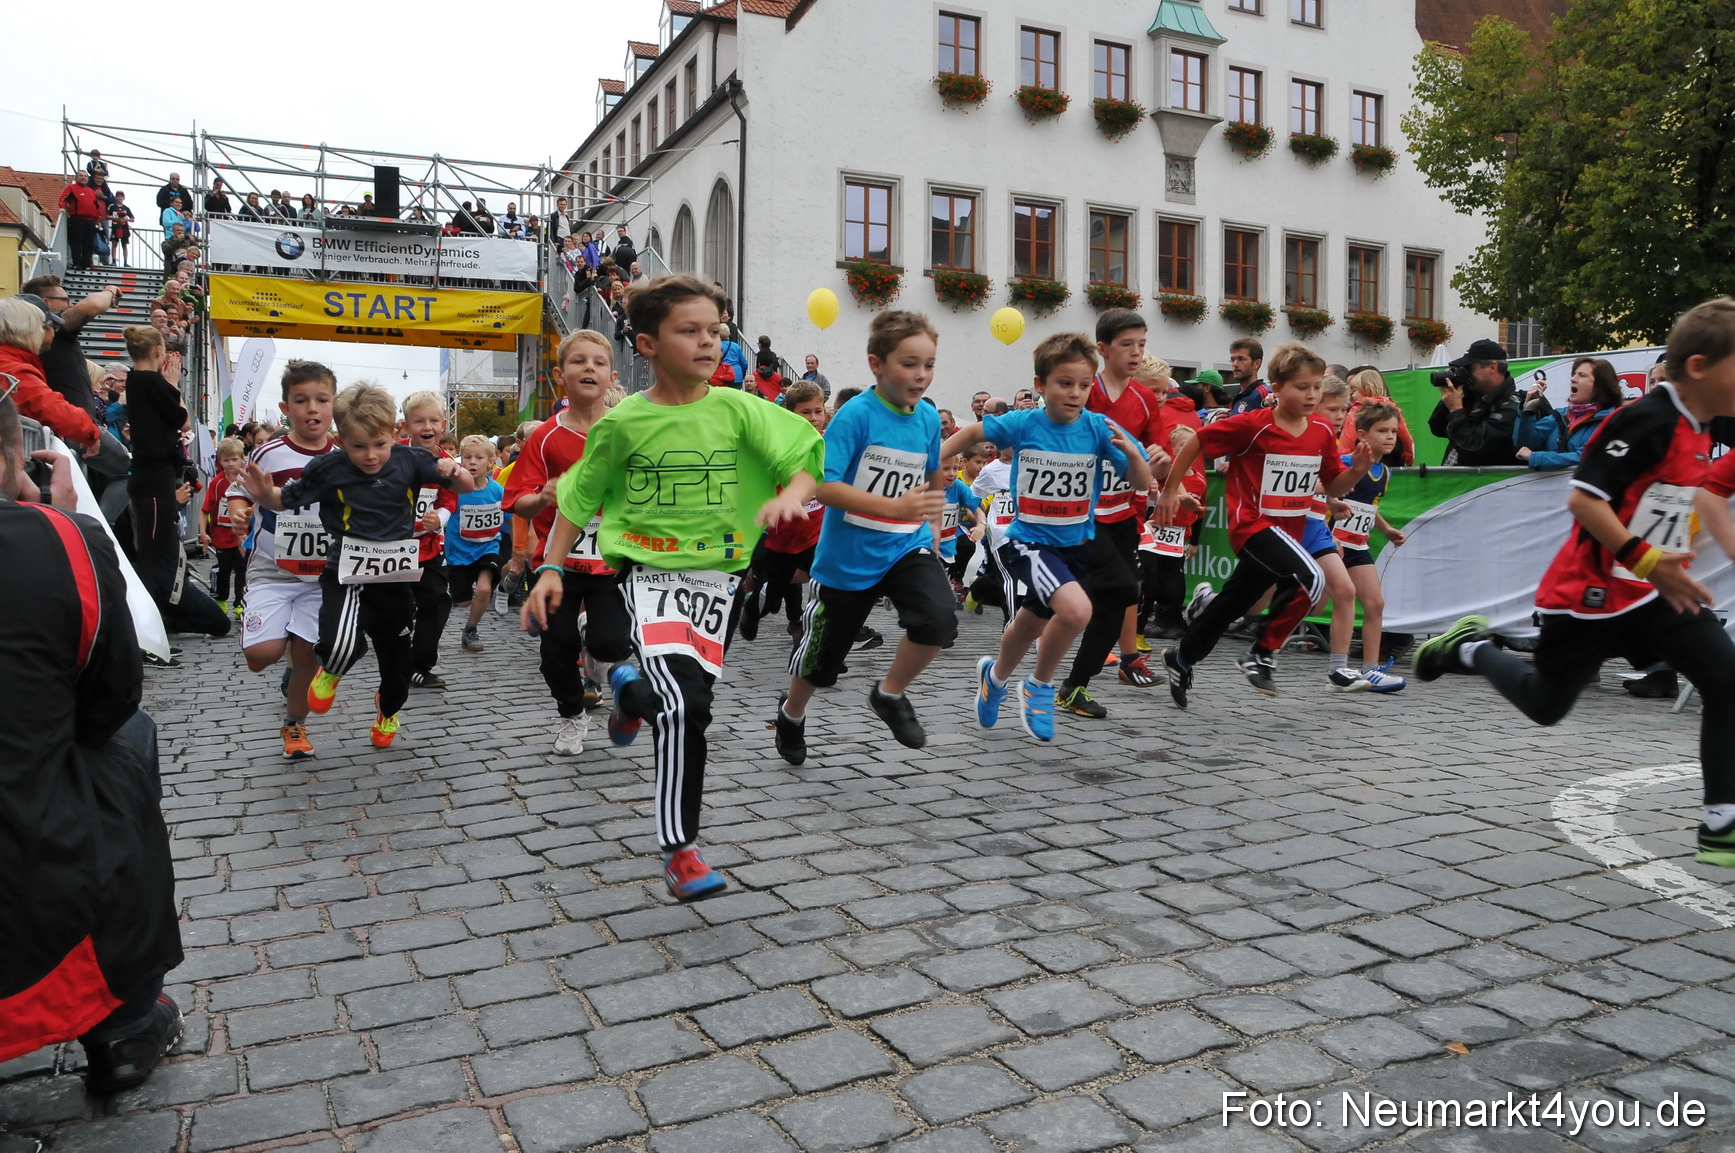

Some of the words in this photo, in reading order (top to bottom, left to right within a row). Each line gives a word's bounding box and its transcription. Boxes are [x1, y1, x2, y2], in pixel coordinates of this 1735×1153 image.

[312, 237, 351, 251] BMW
[354, 240, 480, 259] EfficientDynamics
[312, 251, 351, 262] Weniger
[353, 253, 402, 265] Verbrauch.
[404, 257, 428, 266] Mehr
[228, 299, 270, 308] Neumarkter
[271, 301, 304, 310] Stadtlauf
[323, 290, 437, 322] START
[456, 312, 494, 320] Neumarkter
[242, 379, 254, 403] BKK
[863, 452, 893, 466] PARTL
[1020, 455, 1044, 466] PARTL
[1046, 459, 1085, 468] Neumarkt
[1266, 460, 1290, 468] PARTL
[1025, 468, 1088, 498] 7233
[1271, 470, 1320, 494] 7047
[998, 500, 1015, 514] 70
[278, 521, 303, 529] PARTL
[464, 512, 501, 529] 7535
[943, 512, 957, 528] 71
[1151, 525, 1182, 545] 7551
[283, 532, 329, 557] 705
[348, 556, 412, 577] 7596
[573, 561, 594, 573] Erik
[636, 572, 675, 585] PARTL
[677, 572, 724, 592] Neumarkt
